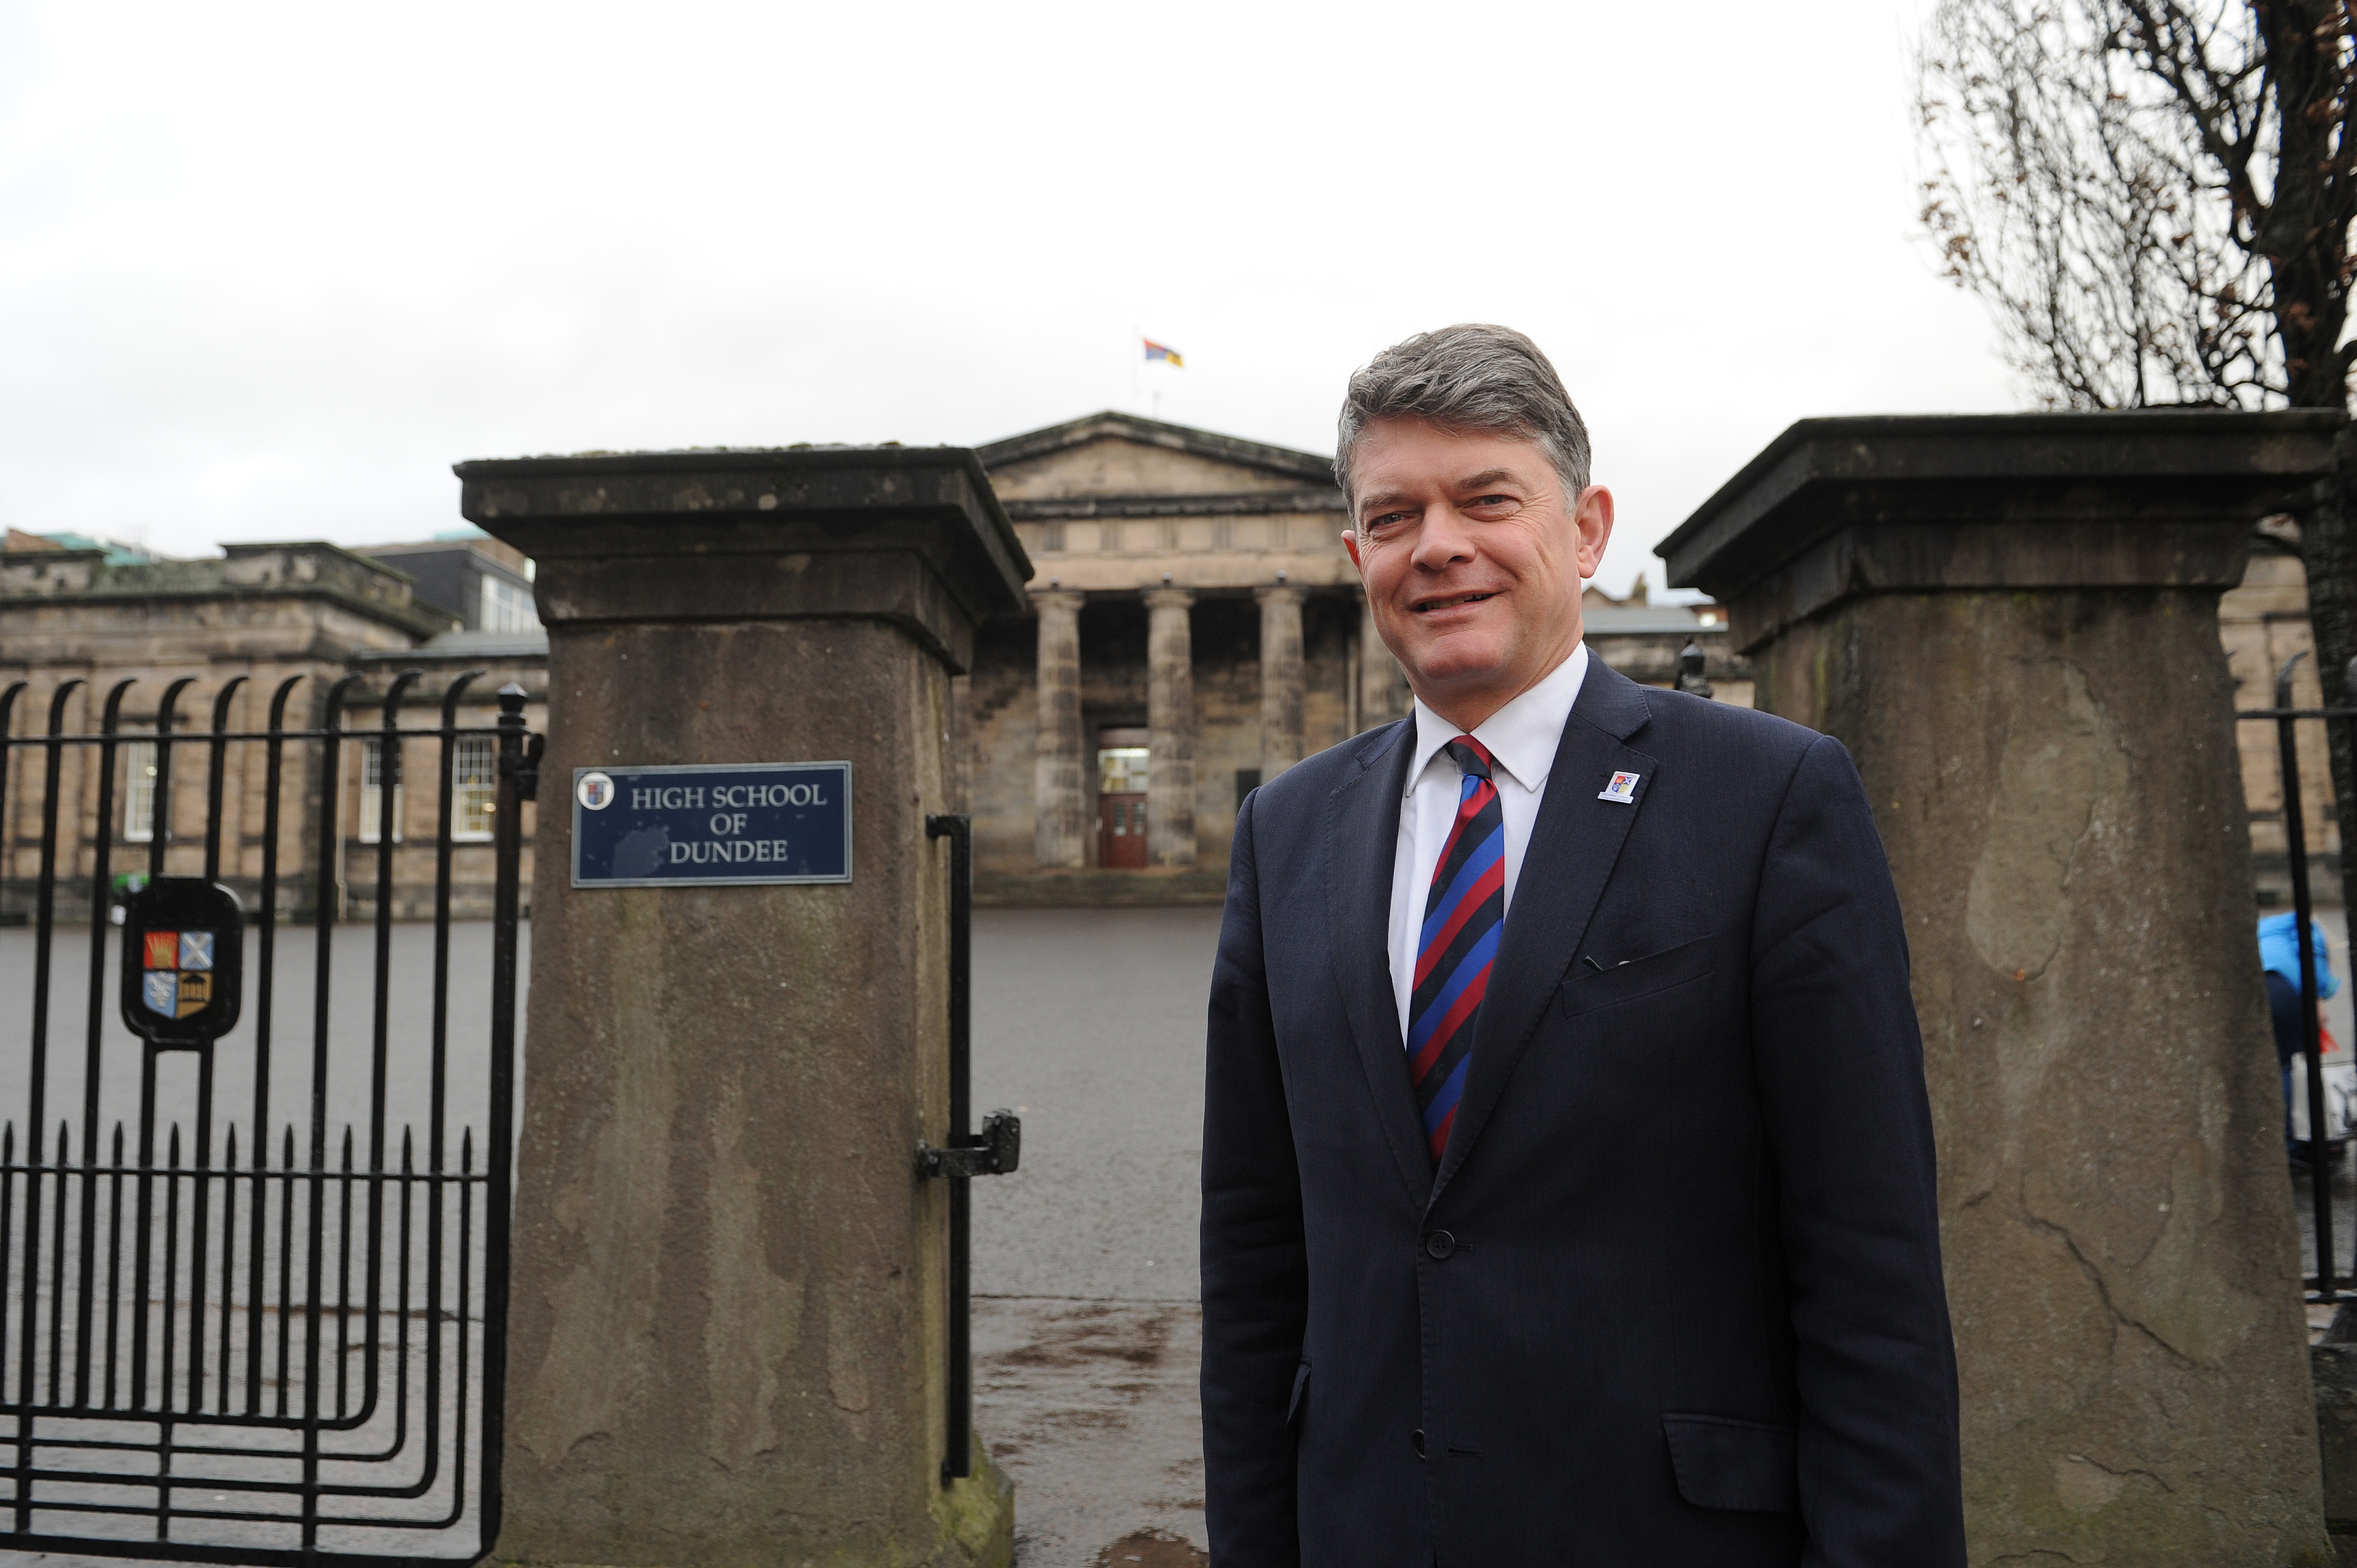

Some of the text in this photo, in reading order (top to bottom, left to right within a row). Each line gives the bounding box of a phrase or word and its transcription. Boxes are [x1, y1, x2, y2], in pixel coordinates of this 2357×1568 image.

[632, 785, 827, 809] HIGH SCHOOL
[710, 814, 747, 835] OF
[670, 841, 788, 863] DUNDEE
